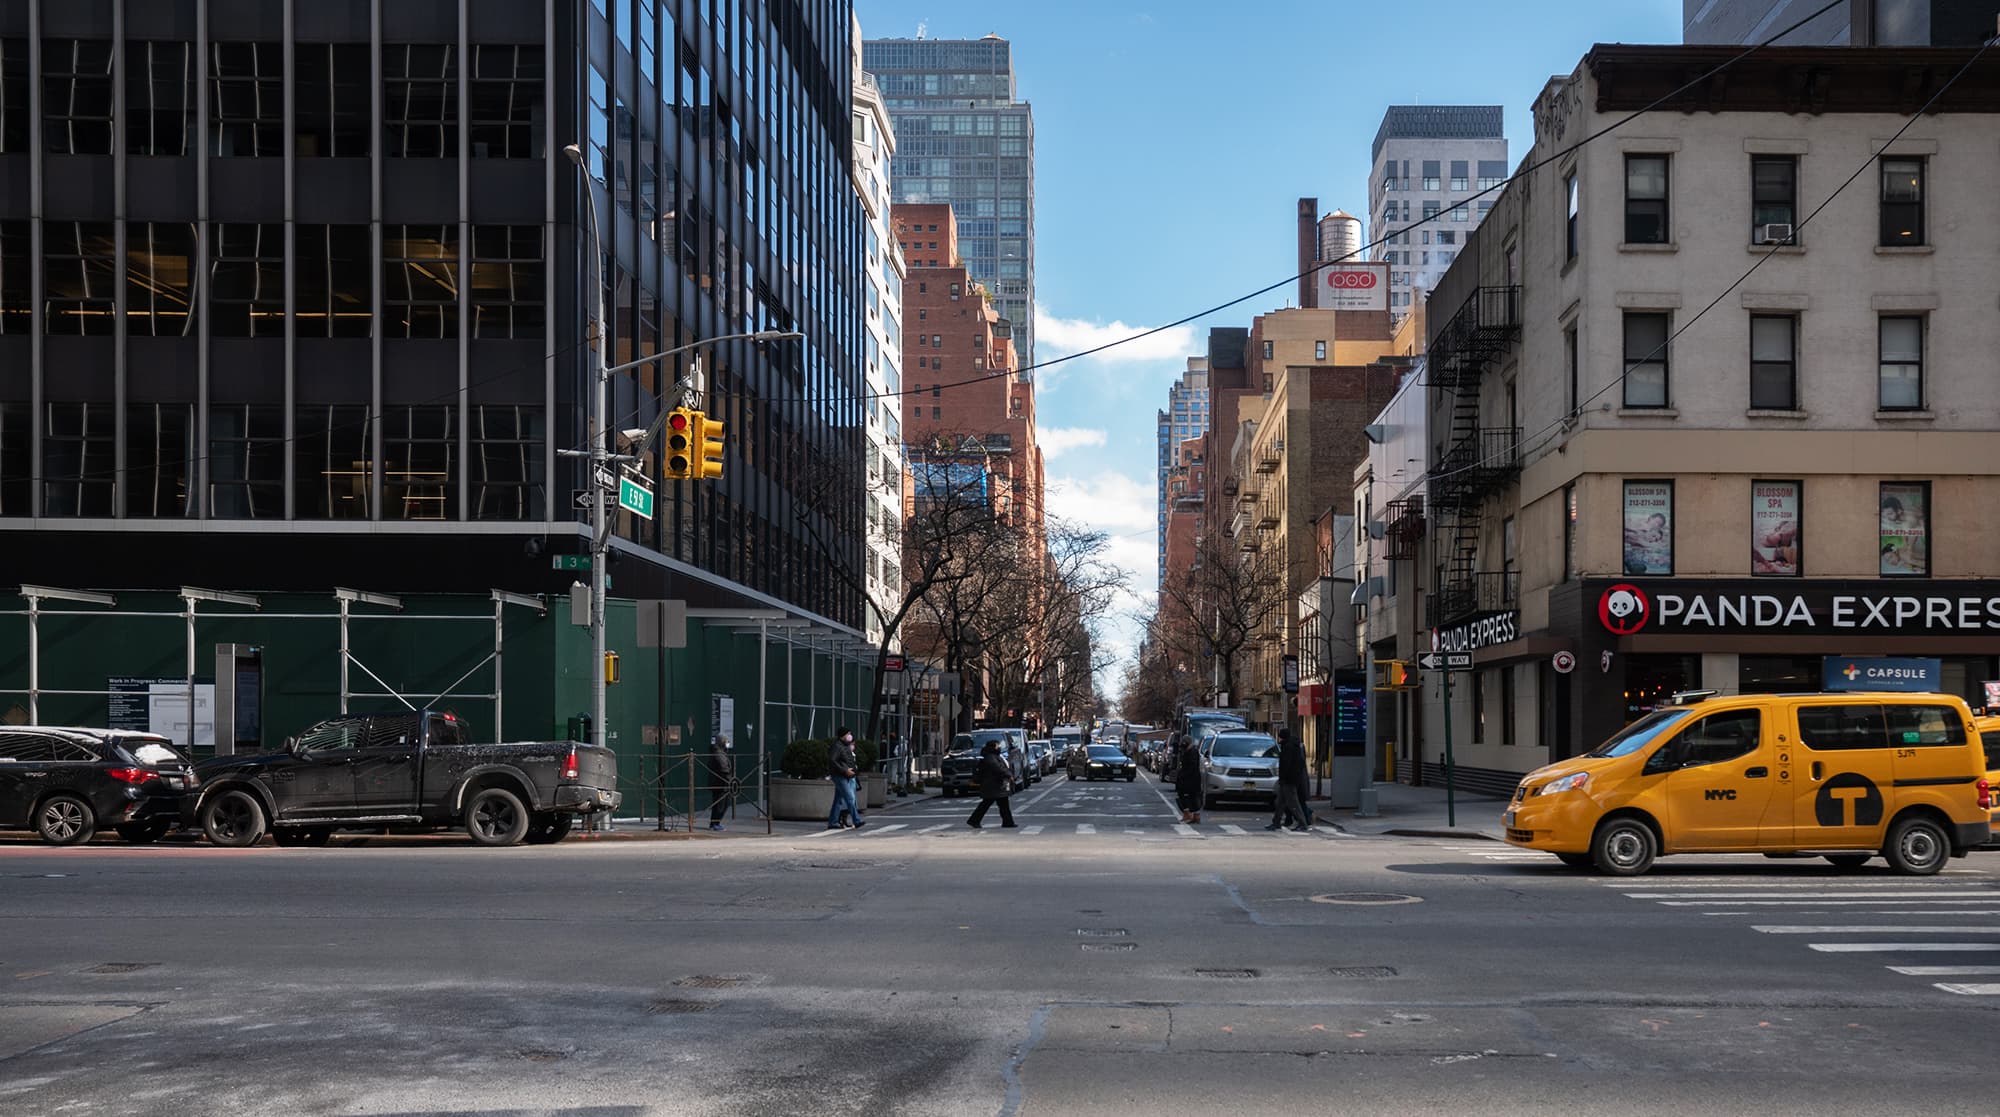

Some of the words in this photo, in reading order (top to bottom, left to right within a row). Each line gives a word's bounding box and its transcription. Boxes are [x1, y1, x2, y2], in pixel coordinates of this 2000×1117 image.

[1332, 271, 1372, 288] pod
[1757, 487, 1793, 497] BLOSSOM
[1768, 498, 1783, 508] SPA
[569, 557, 577, 568] 3
[1657, 595, 1816, 627] PANDA
[1440, 624, 1469, 652] PANDA
[1470, 611, 1515, 649] EXPRESS
[1451, 656, 1466, 664] WAY
[1867, 668, 1926, 679] CAPSULE
[1704, 790, 1736, 801] NYC
